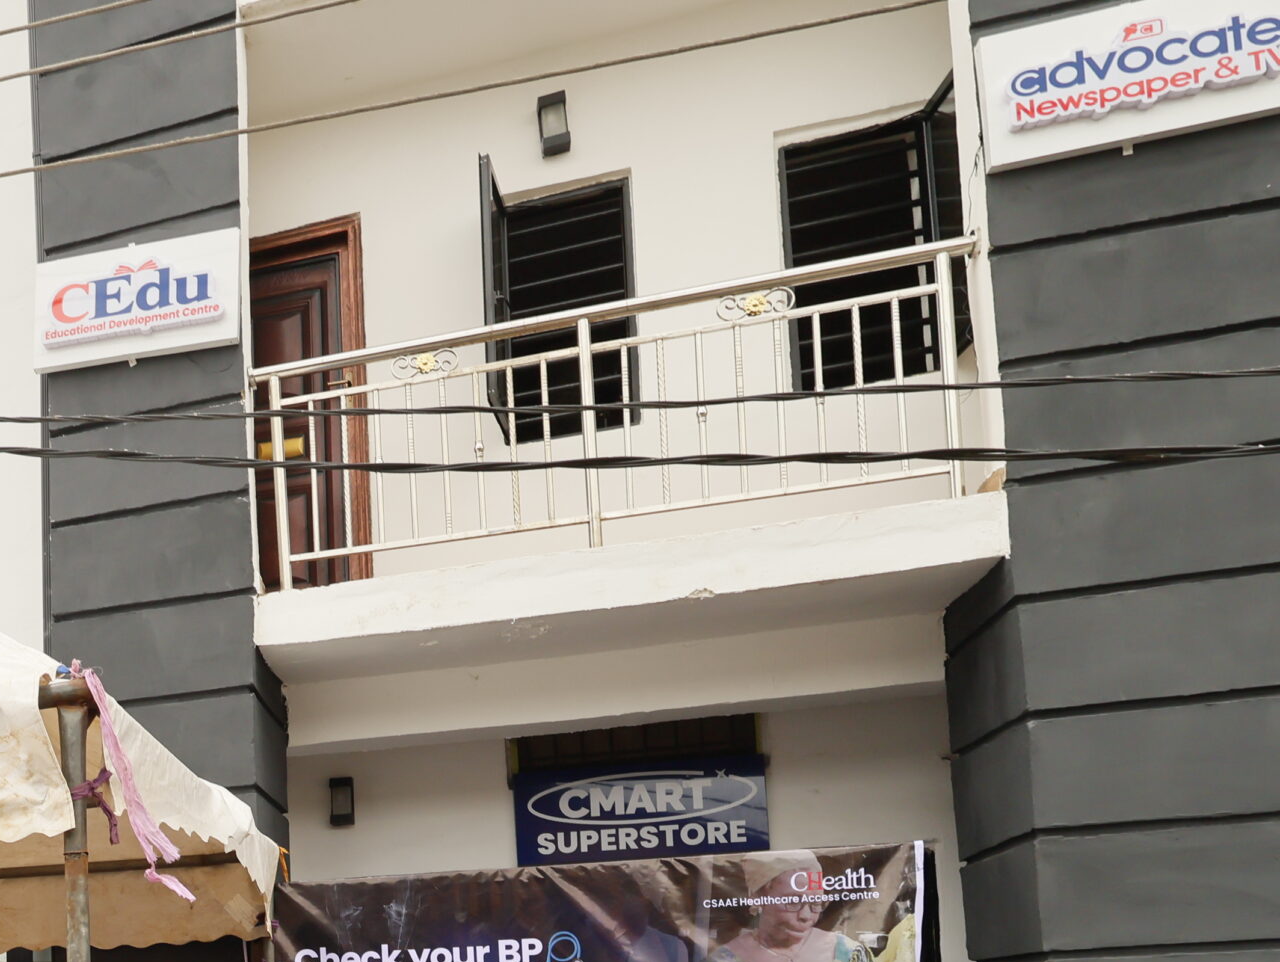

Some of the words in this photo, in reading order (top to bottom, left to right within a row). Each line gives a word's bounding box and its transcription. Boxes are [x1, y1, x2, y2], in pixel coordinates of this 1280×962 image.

[1011, 16, 1280, 96] advocate
[1016, 67, 1207, 120] Newspaper
[1214, 56, 1240, 79] &
[51, 267, 212, 323] CEdu
[45, 322, 106, 340] Educational
[109, 311, 181, 329] Development
[182, 303, 219, 317] Centre
[558, 778, 712, 819] CMART
[537, 820, 747, 855] SUPERSTORE
[790, 867, 876, 892] CHealth
[703, 898, 738, 909] CSAAE
[739, 895, 800, 907] Healthcare
[801, 891, 840, 902] Access
[842, 890, 880, 901] Centre
